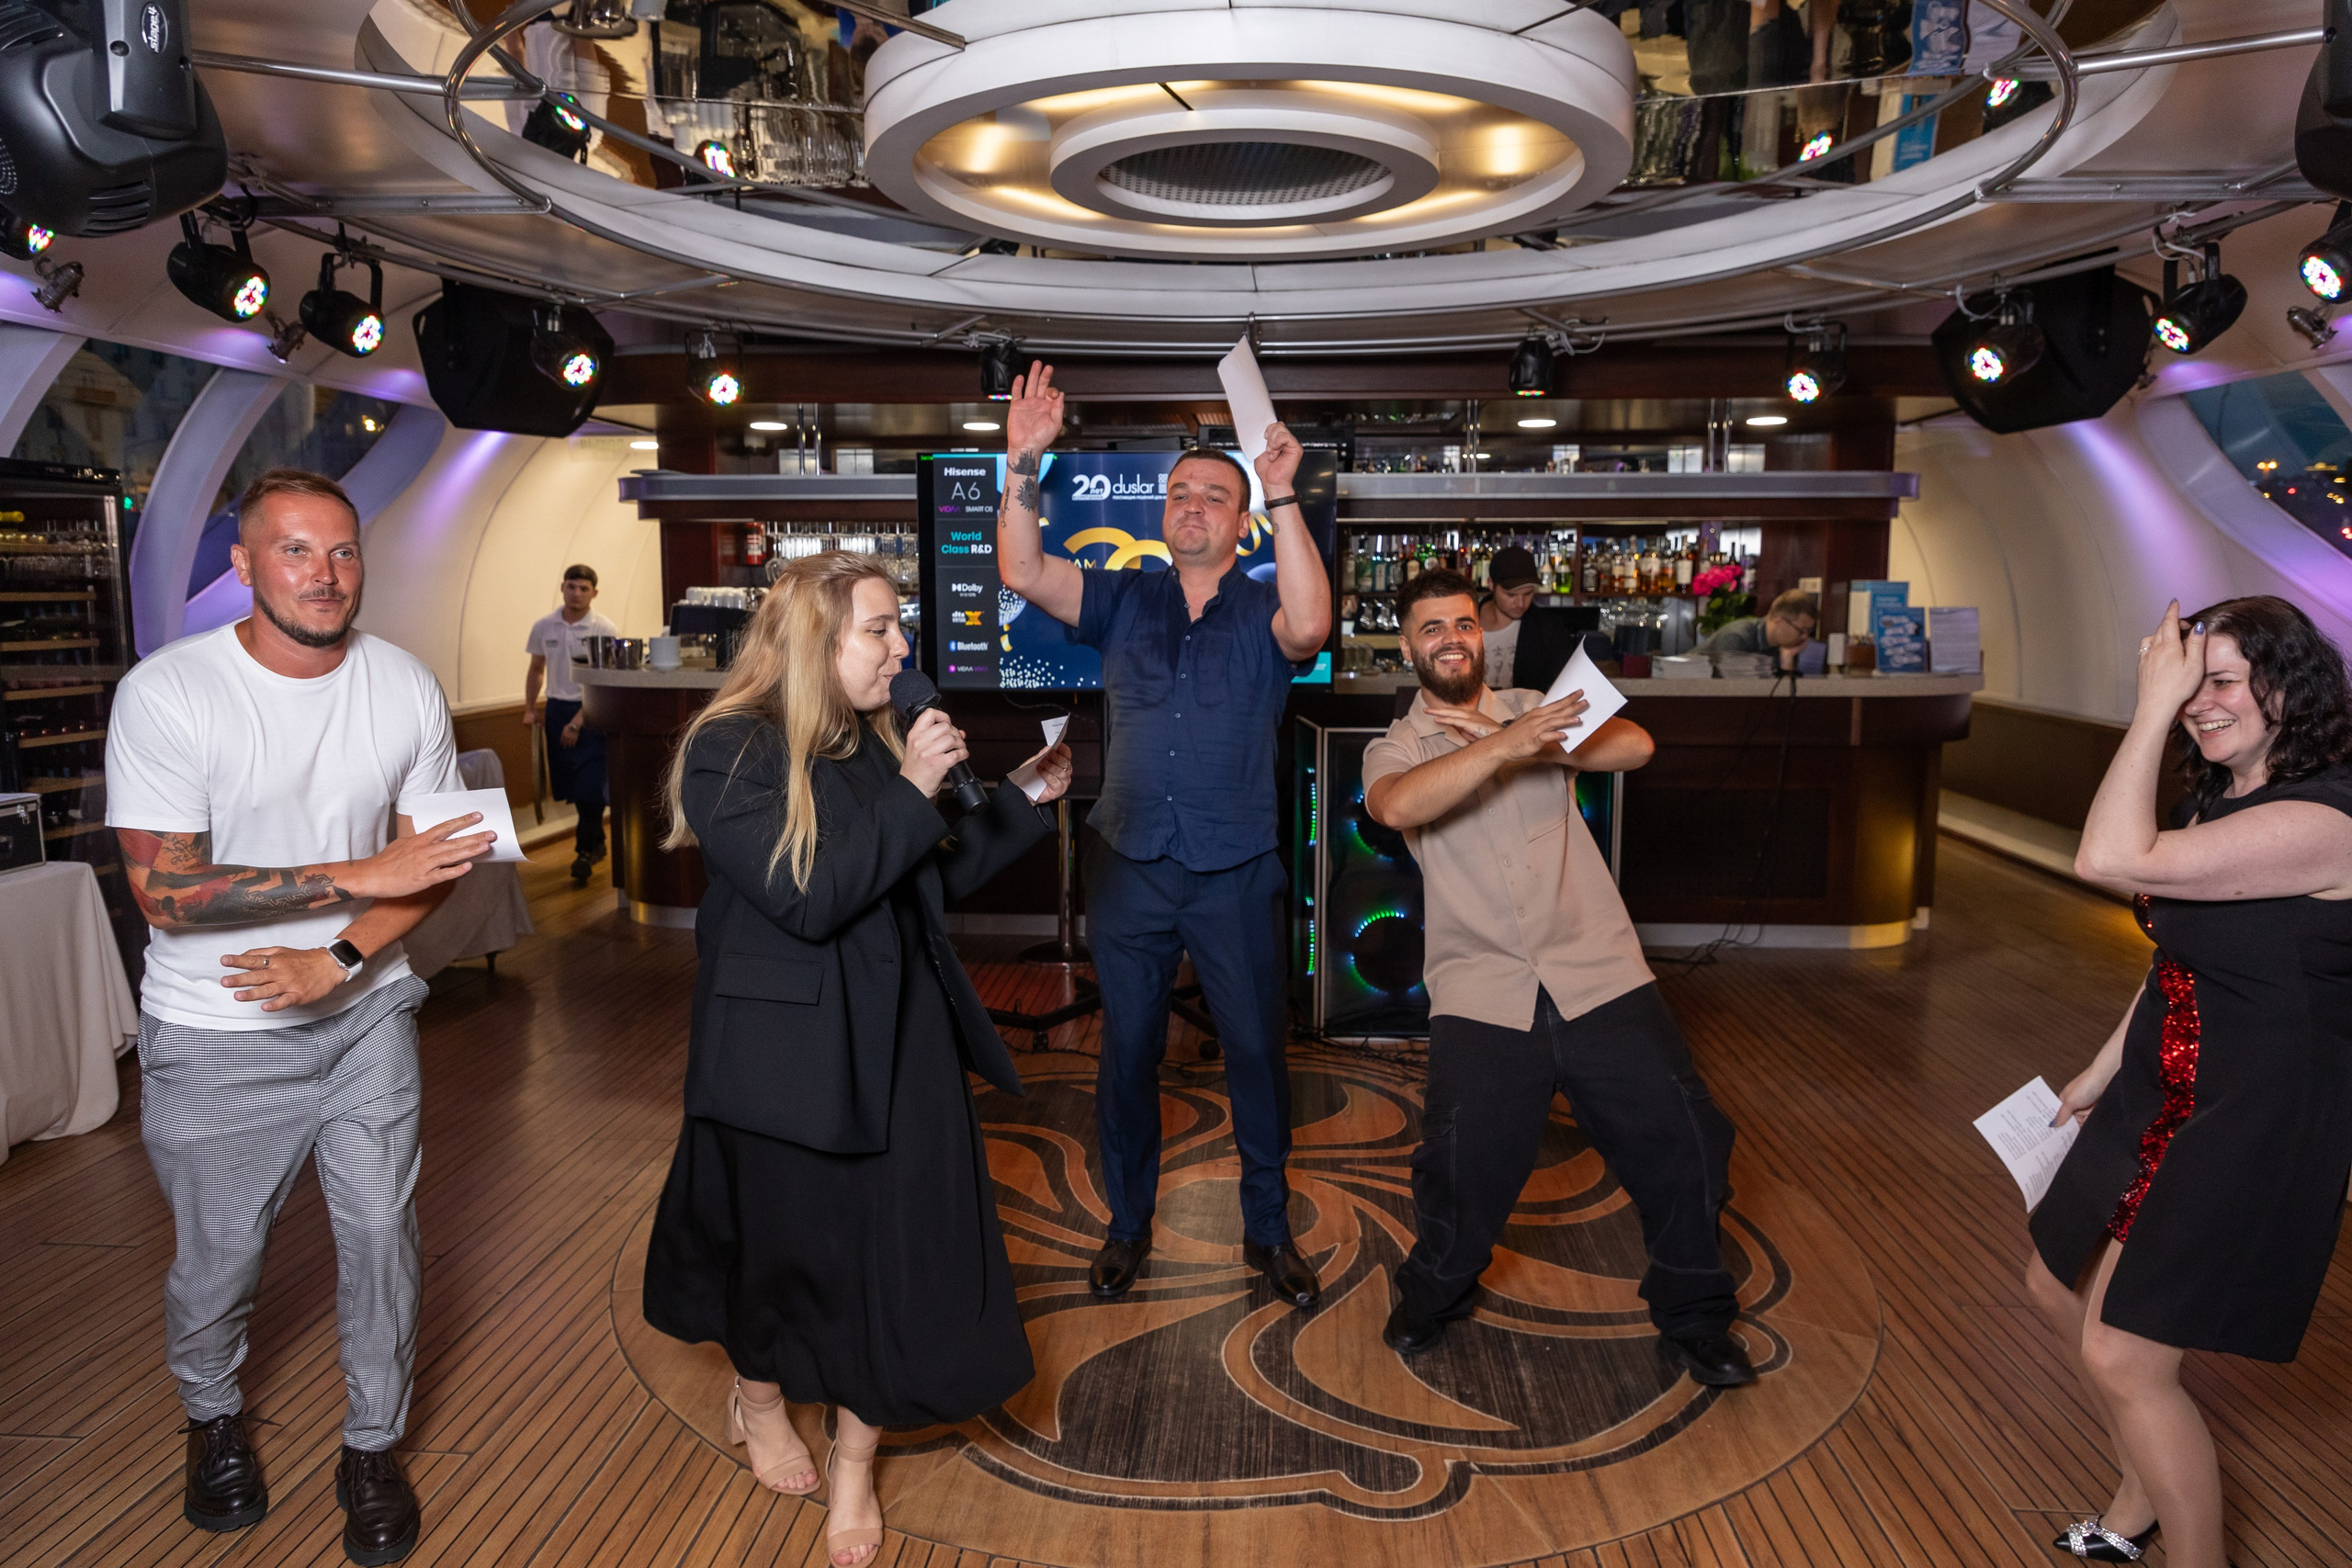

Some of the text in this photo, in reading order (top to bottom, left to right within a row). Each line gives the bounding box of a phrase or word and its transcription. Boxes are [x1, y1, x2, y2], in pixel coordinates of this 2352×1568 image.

[944, 467, 987, 477] Hisense
[951, 481, 981, 501] A6
[1071, 473, 1155, 501] 20 duslar
[950, 531, 982, 541] World
[941, 544, 993, 555] Class R&D
[962, 583, 984, 594] Dolby
[956, 641, 989, 651] Bluetooth
